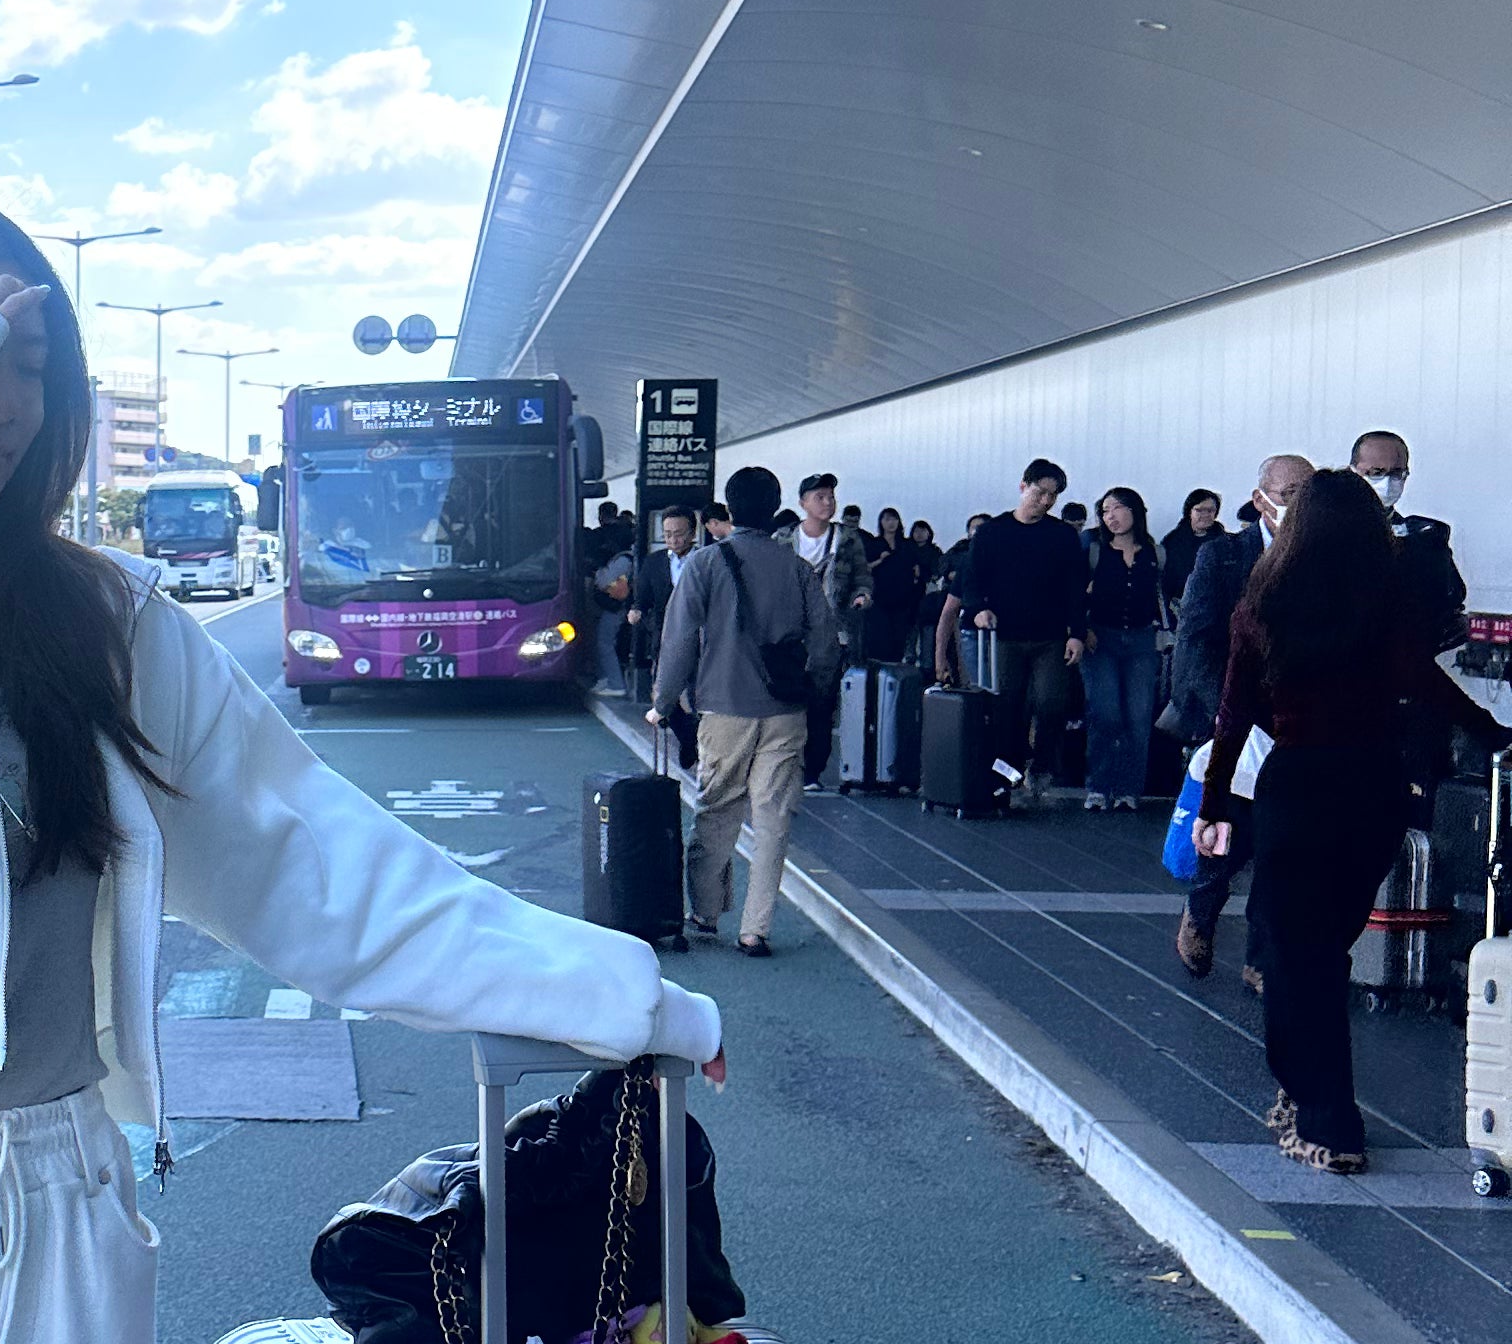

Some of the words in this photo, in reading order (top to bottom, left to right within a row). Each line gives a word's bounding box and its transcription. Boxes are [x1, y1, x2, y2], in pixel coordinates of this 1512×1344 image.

[649, 389, 663, 414] 1
[647, 437, 708, 453] 連絡バス
[422, 663, 455, 680] 214
